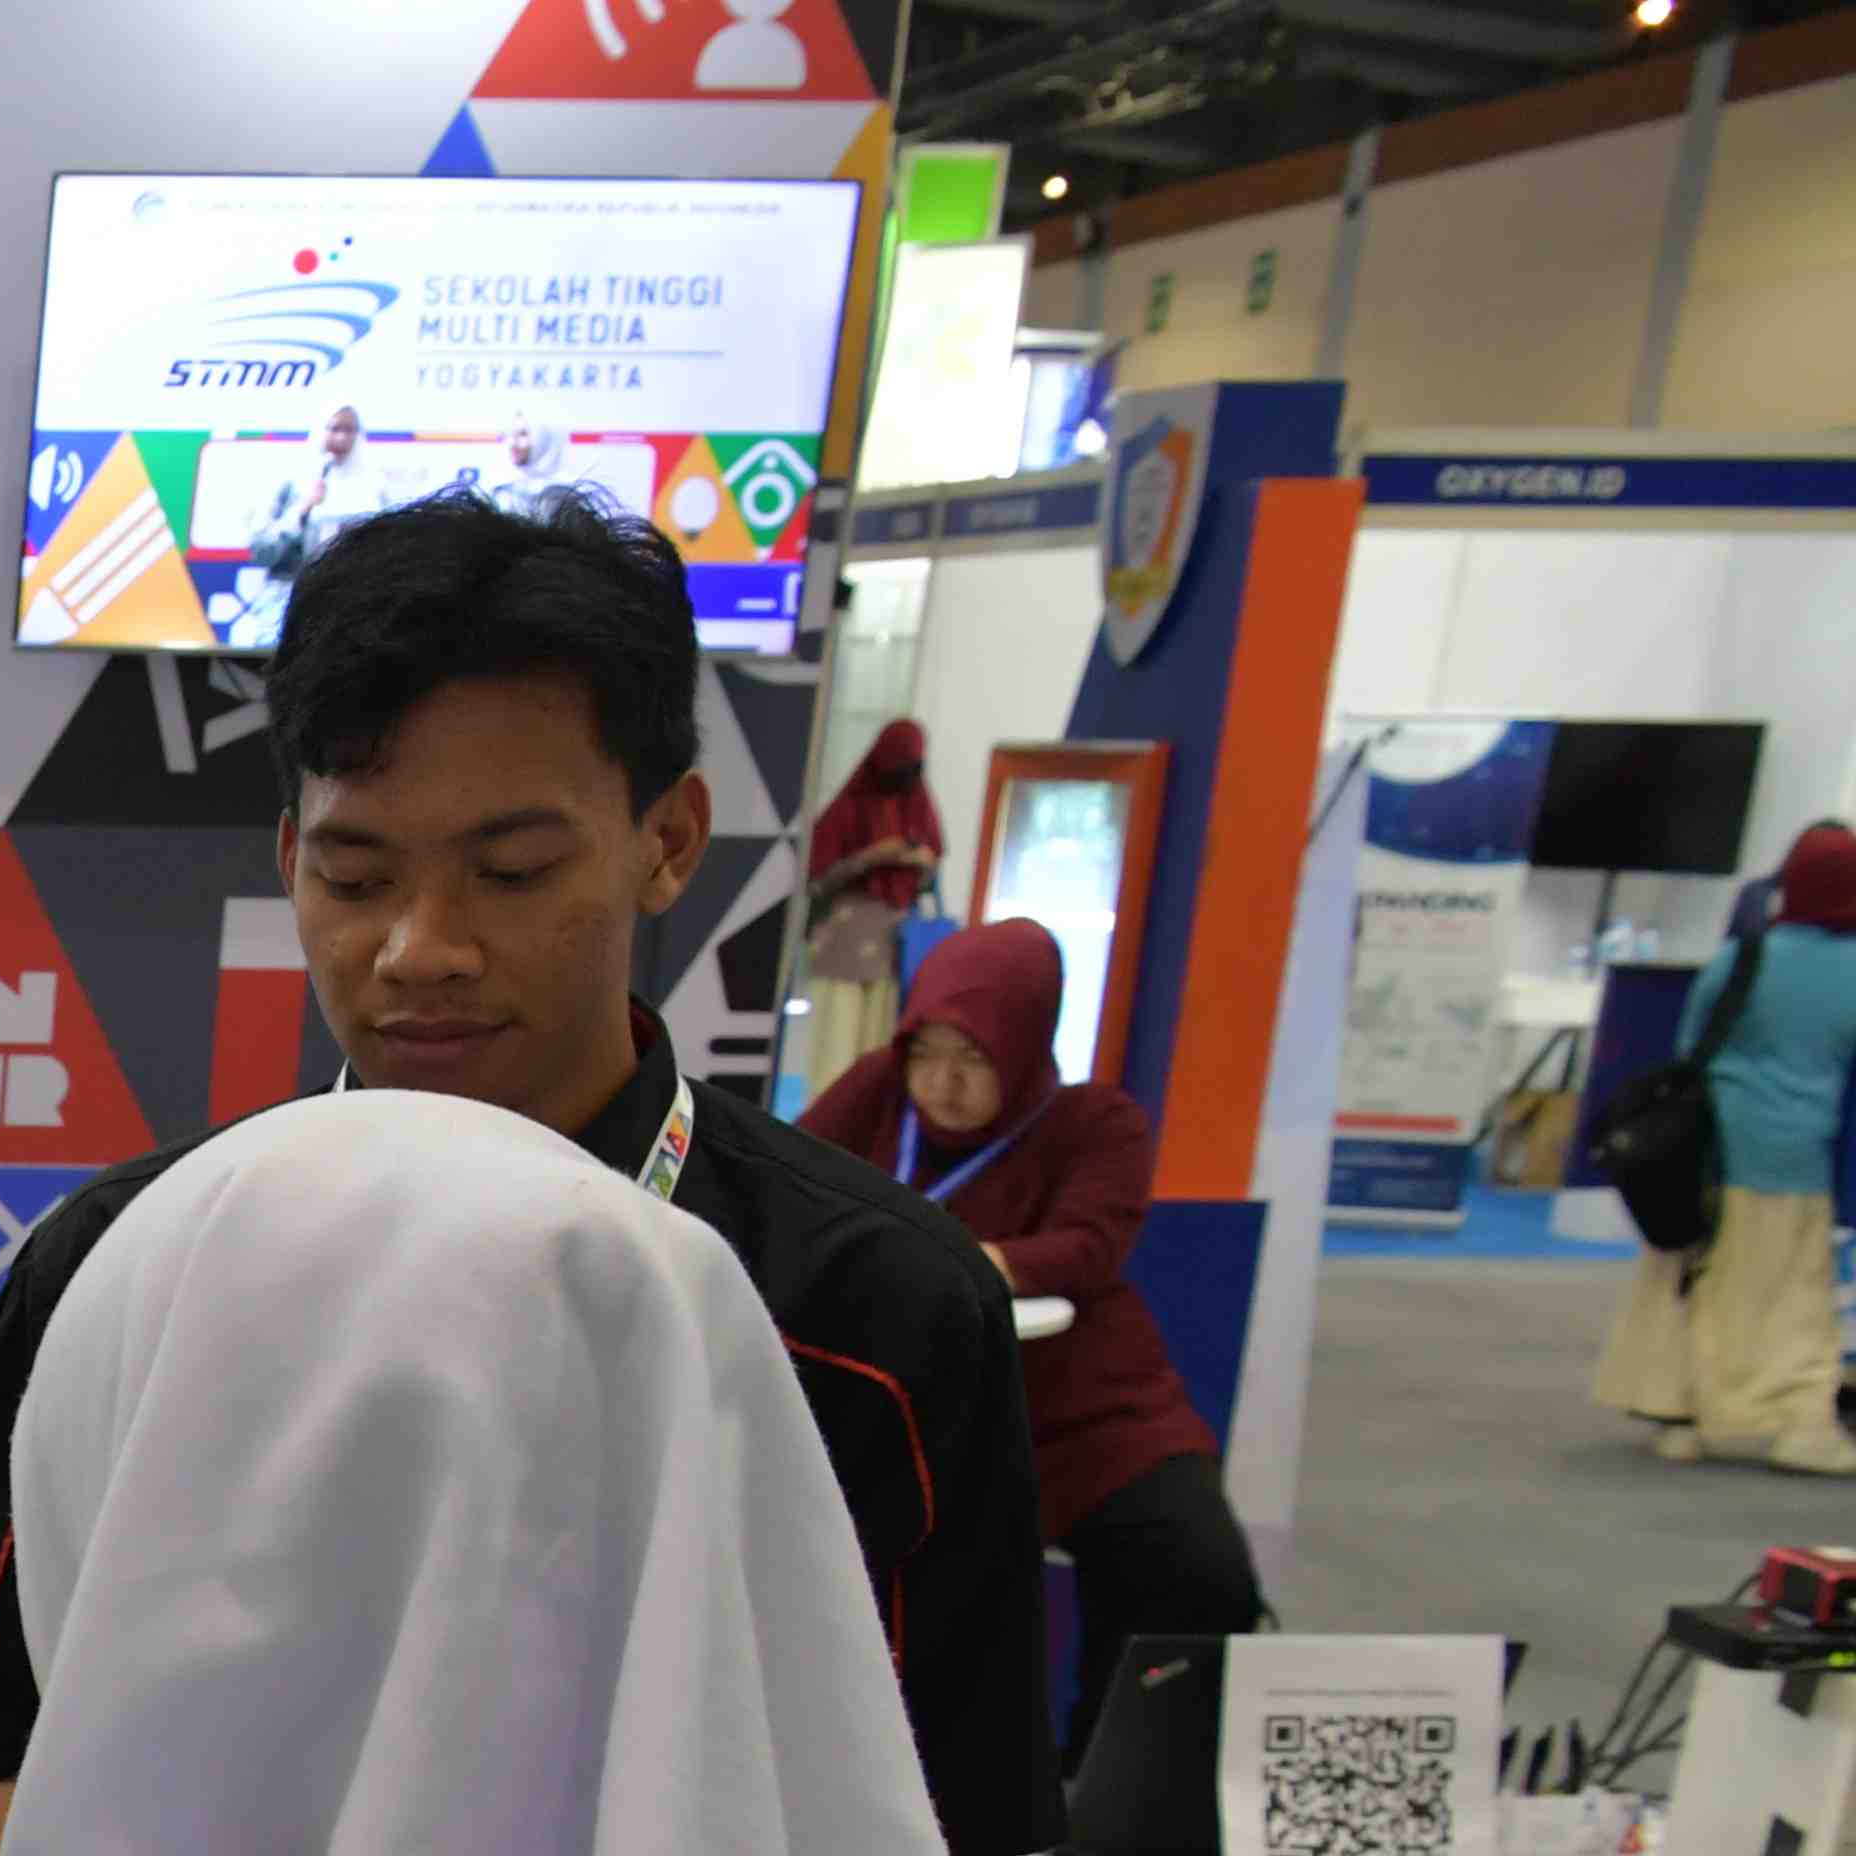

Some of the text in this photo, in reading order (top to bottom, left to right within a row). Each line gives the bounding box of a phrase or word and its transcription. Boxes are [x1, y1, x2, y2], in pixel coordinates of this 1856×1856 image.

[422, 275, 723, 307] SEKOLAH TINGGI
[416, 314, 647, 345] MULTI MEDIA
[415, 364, 644, 390] YOGYAKARTA
